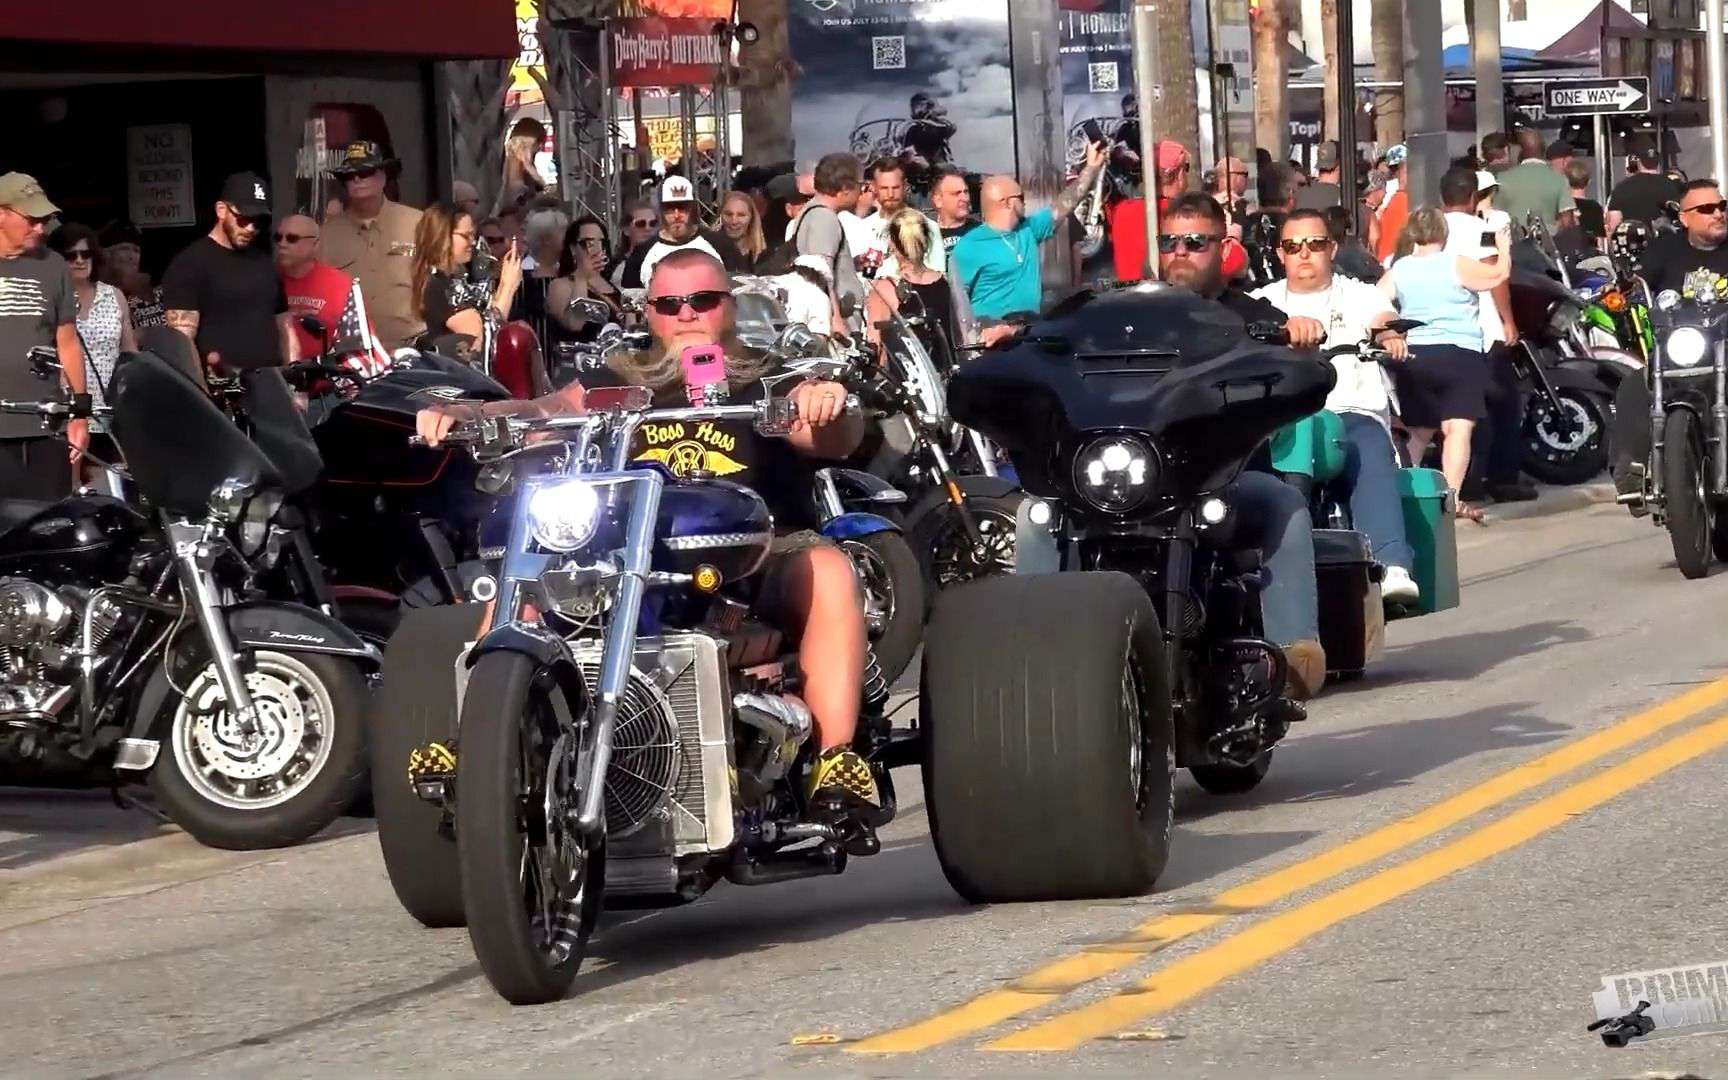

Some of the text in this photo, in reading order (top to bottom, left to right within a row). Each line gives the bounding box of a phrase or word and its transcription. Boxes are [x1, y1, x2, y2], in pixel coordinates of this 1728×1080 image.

[852, 17, 869, 25] JULY
[671, 34, 722, 64] OUTBACK
[1554, 89, 1617, 105] ONE WAY
[144, 132, 175, 150] NO
[253, 183, 267, 200] LA
[641, 422, 736, 452] Boss Hoss
